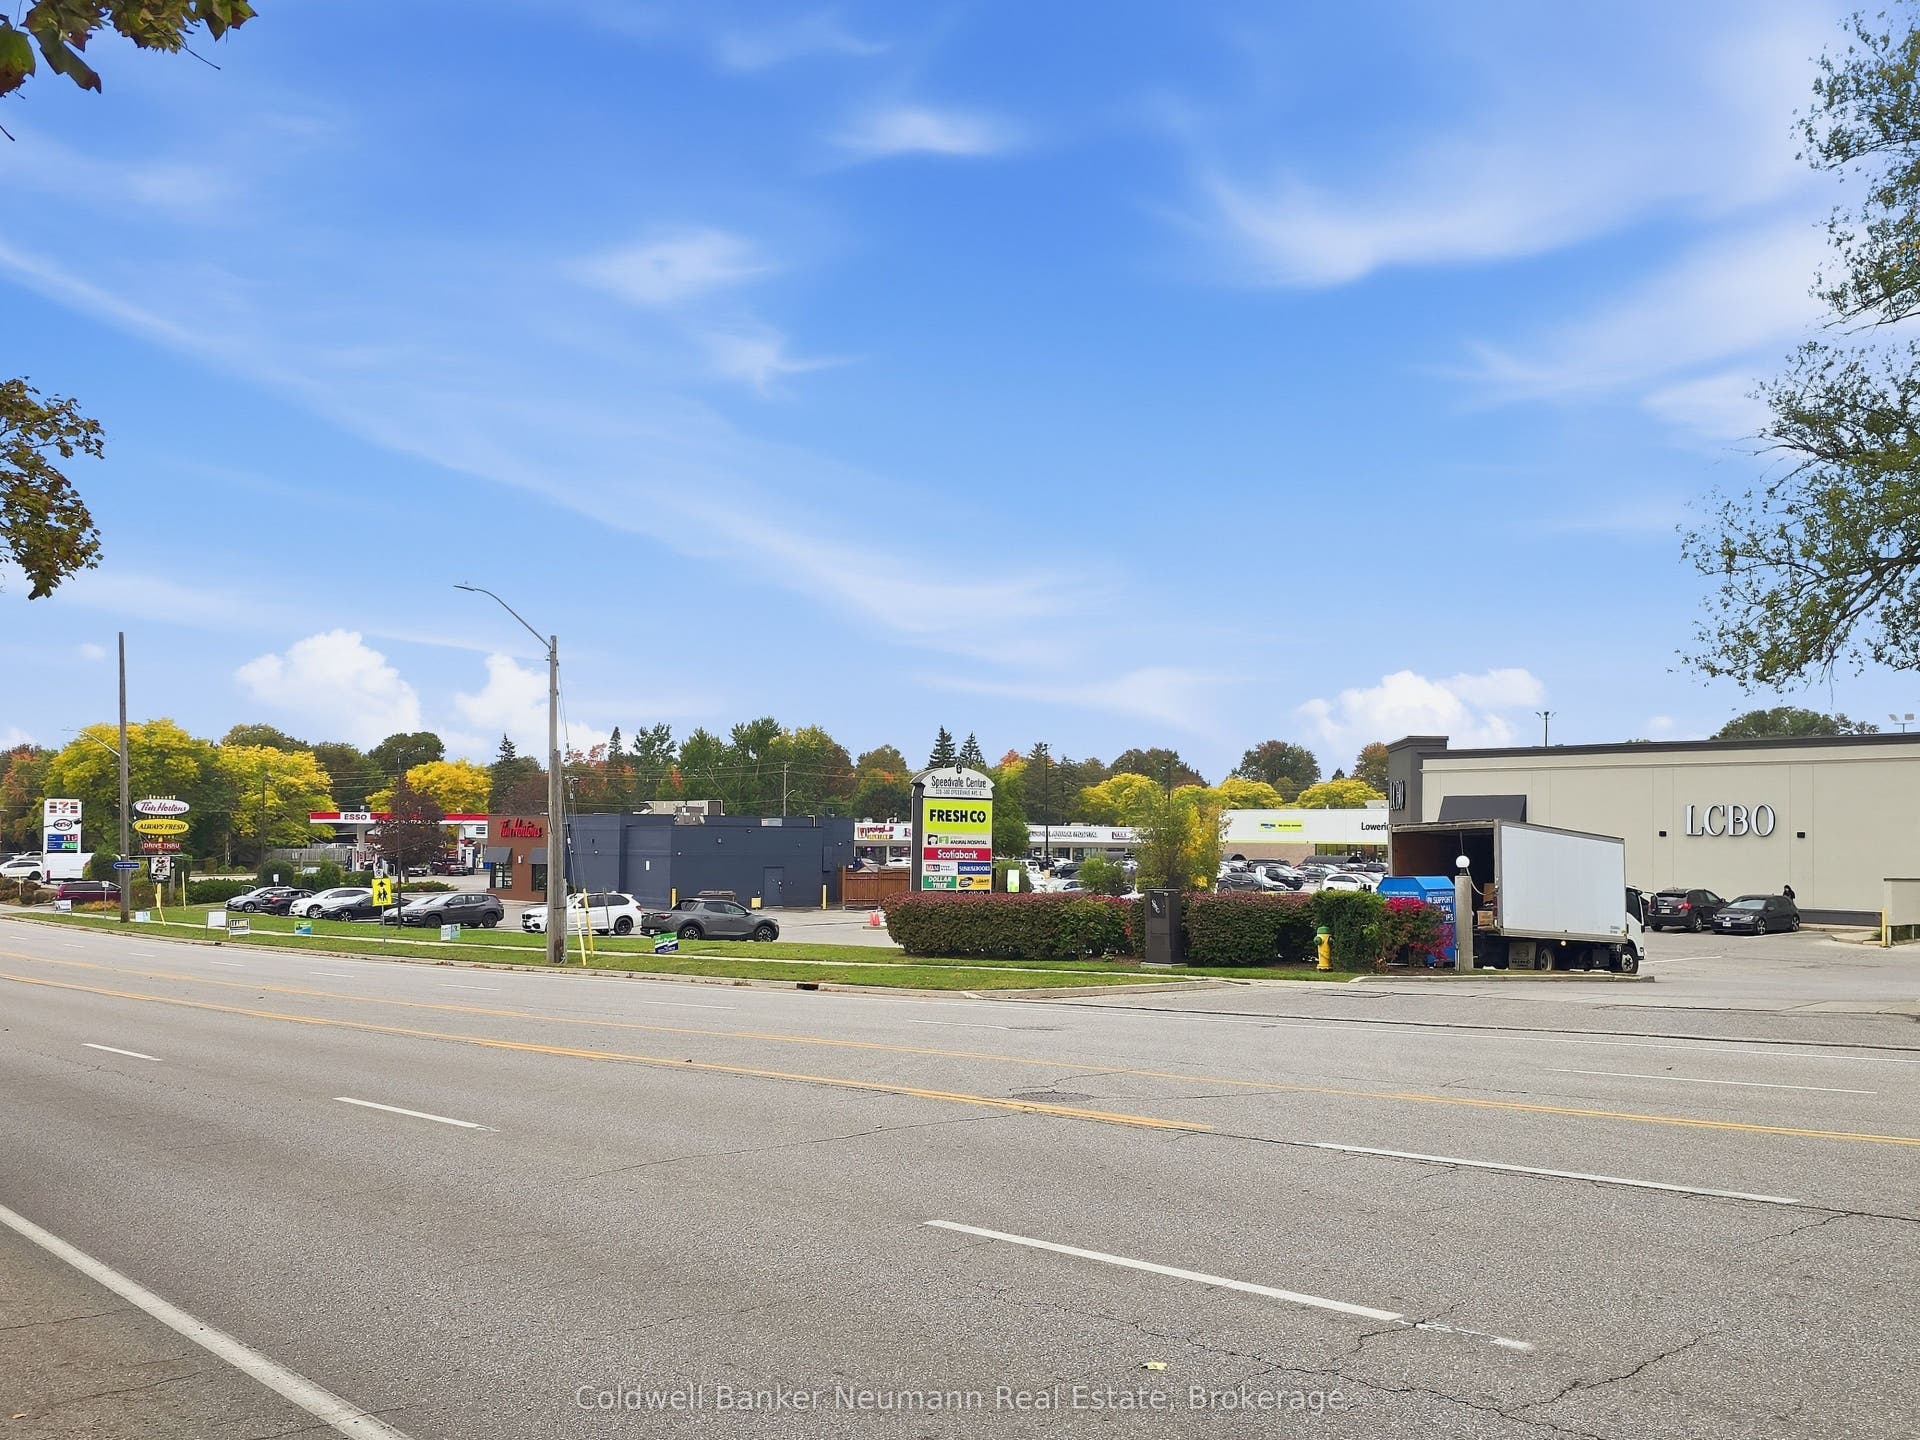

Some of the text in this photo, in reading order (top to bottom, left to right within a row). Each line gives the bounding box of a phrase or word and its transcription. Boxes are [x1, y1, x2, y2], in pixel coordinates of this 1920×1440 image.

[931, 775, 987, 788] Speedvale Centre
[140, 801, 187, 812] Tim Hortons
[344, 813, 368, 821] ESSO
[1685, 802, 1776, 838] LCBO
[937, 849, 978, 860] Scotiabank
[1433, 896, 1453, 904] SUPPORT
